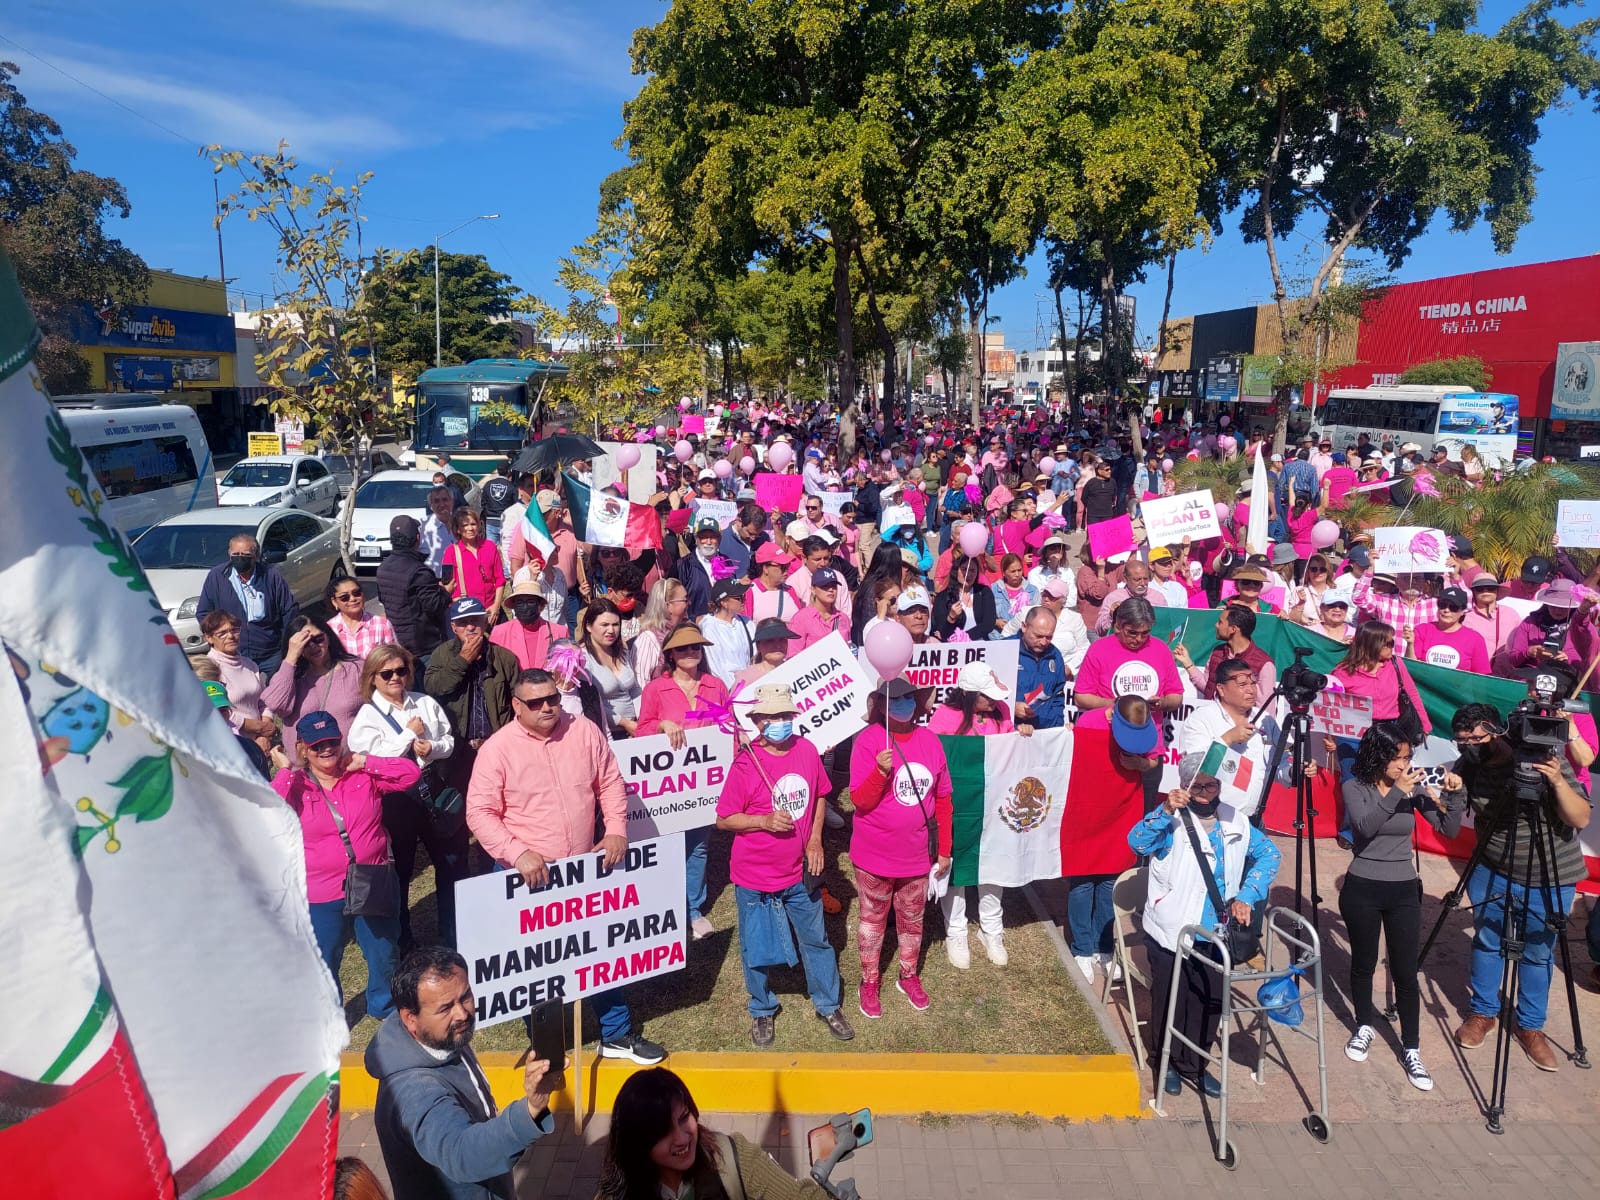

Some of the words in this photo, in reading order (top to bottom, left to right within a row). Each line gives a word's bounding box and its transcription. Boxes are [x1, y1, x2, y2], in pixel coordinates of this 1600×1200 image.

[1418, 302, 1470, 320] TIENDA
[1474, 296, 1526, 315] CHINA
[1440, 319, 1501, 335] 精品店
[471, 387, 489, 402] 339
[1457, 401, 1490, 410] infinitum
[1151, 511, 1195, 529] PLAN
[1198, 509, 1211, 520] B
[1184, 499, 1204, 511] AL
[908, 649, 941, 668] LAN
[947, 648, 959, 666] B
[965, 648, 986, 665] DE
[791, 657, 841, 695] VENIDA
[816, 673, 854, 702] PIÑA
[630, 750, 674, 776] NO
[683, 744, 717, 767] AL
[624, 771, 697, 799] PLAN
[707, 766, 724, 787] B
[626, 795, 720, 822] #MiVotoNoSeToca
[625, 842, 658, 873] DE
[519, 883, 640, 935] MORENA
[475, 930, 598, 984] MANUAL
[607, 908, 678, 948] PARA
[474, 974, 566, 1022] HACER
[574, 941, 685, 992] TRAMPA
